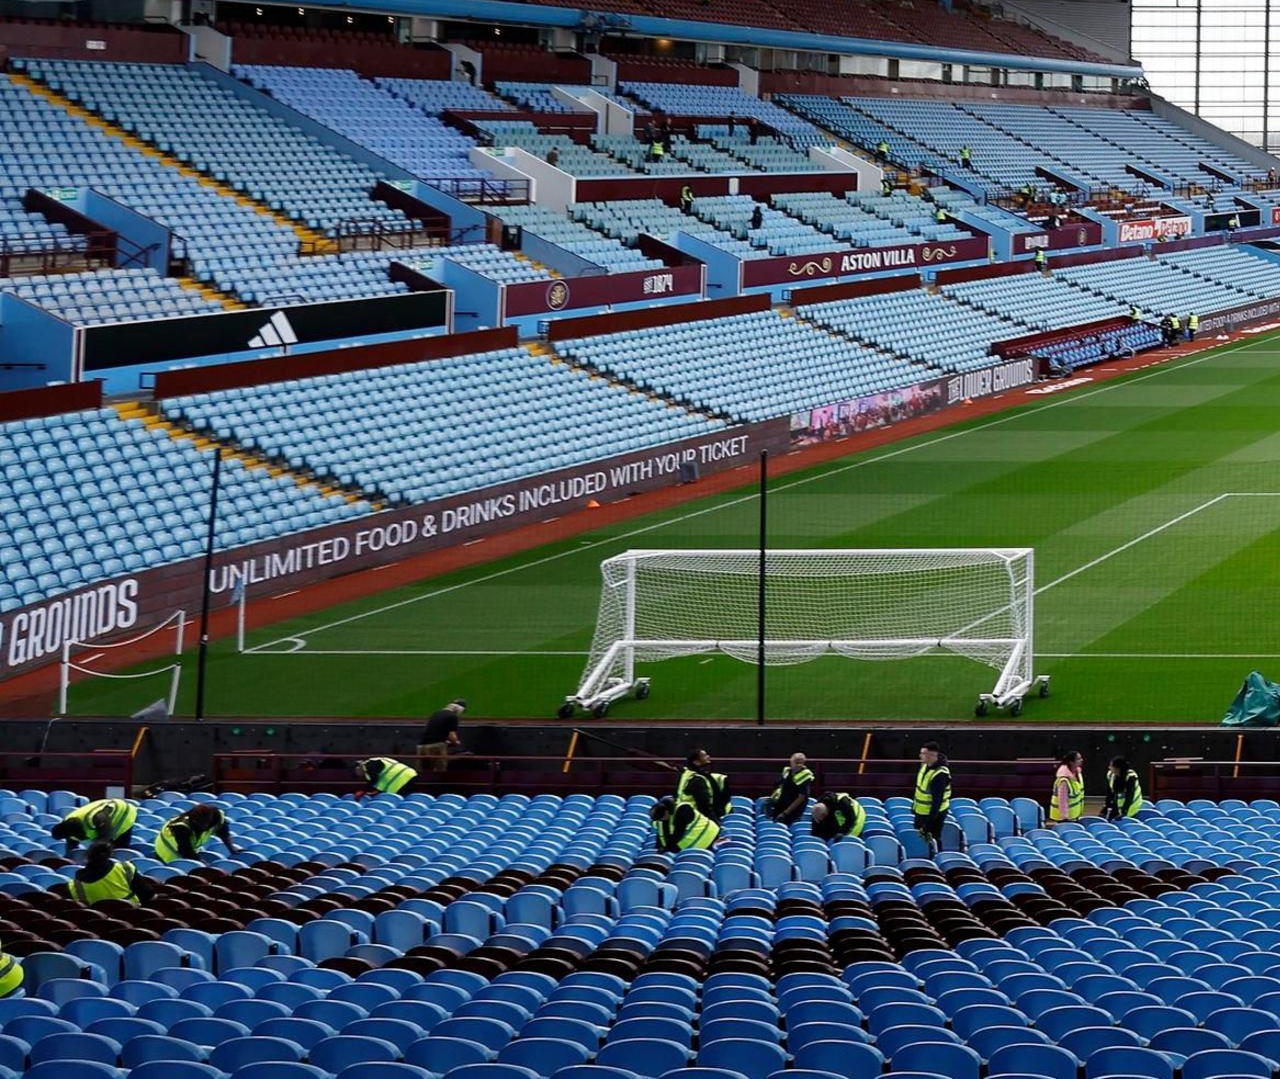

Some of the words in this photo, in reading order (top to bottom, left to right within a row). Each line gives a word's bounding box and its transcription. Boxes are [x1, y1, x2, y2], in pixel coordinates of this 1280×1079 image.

[1120, 224, 1154, 242] Betano
[841, 253, 882, 272] ASTON
[883, 248, 916, 267] VILLA
[960, 368, 993, 400] LOWER
[993, 359, 1034, 392] GROUNDS
[208, 537, 349, 594] UNLIMITED
[355, 520, 417, 555] FOOD
[421, 514, 438, 538] &
[441, 494, 516, 533] DRINKS
[519, 471, 607, 512] INCLUDED
[610, 460, 652, 488] WITH
[699, 435, 749, 464] TICKET
[8, 579, 138, 667] GROUNDS
